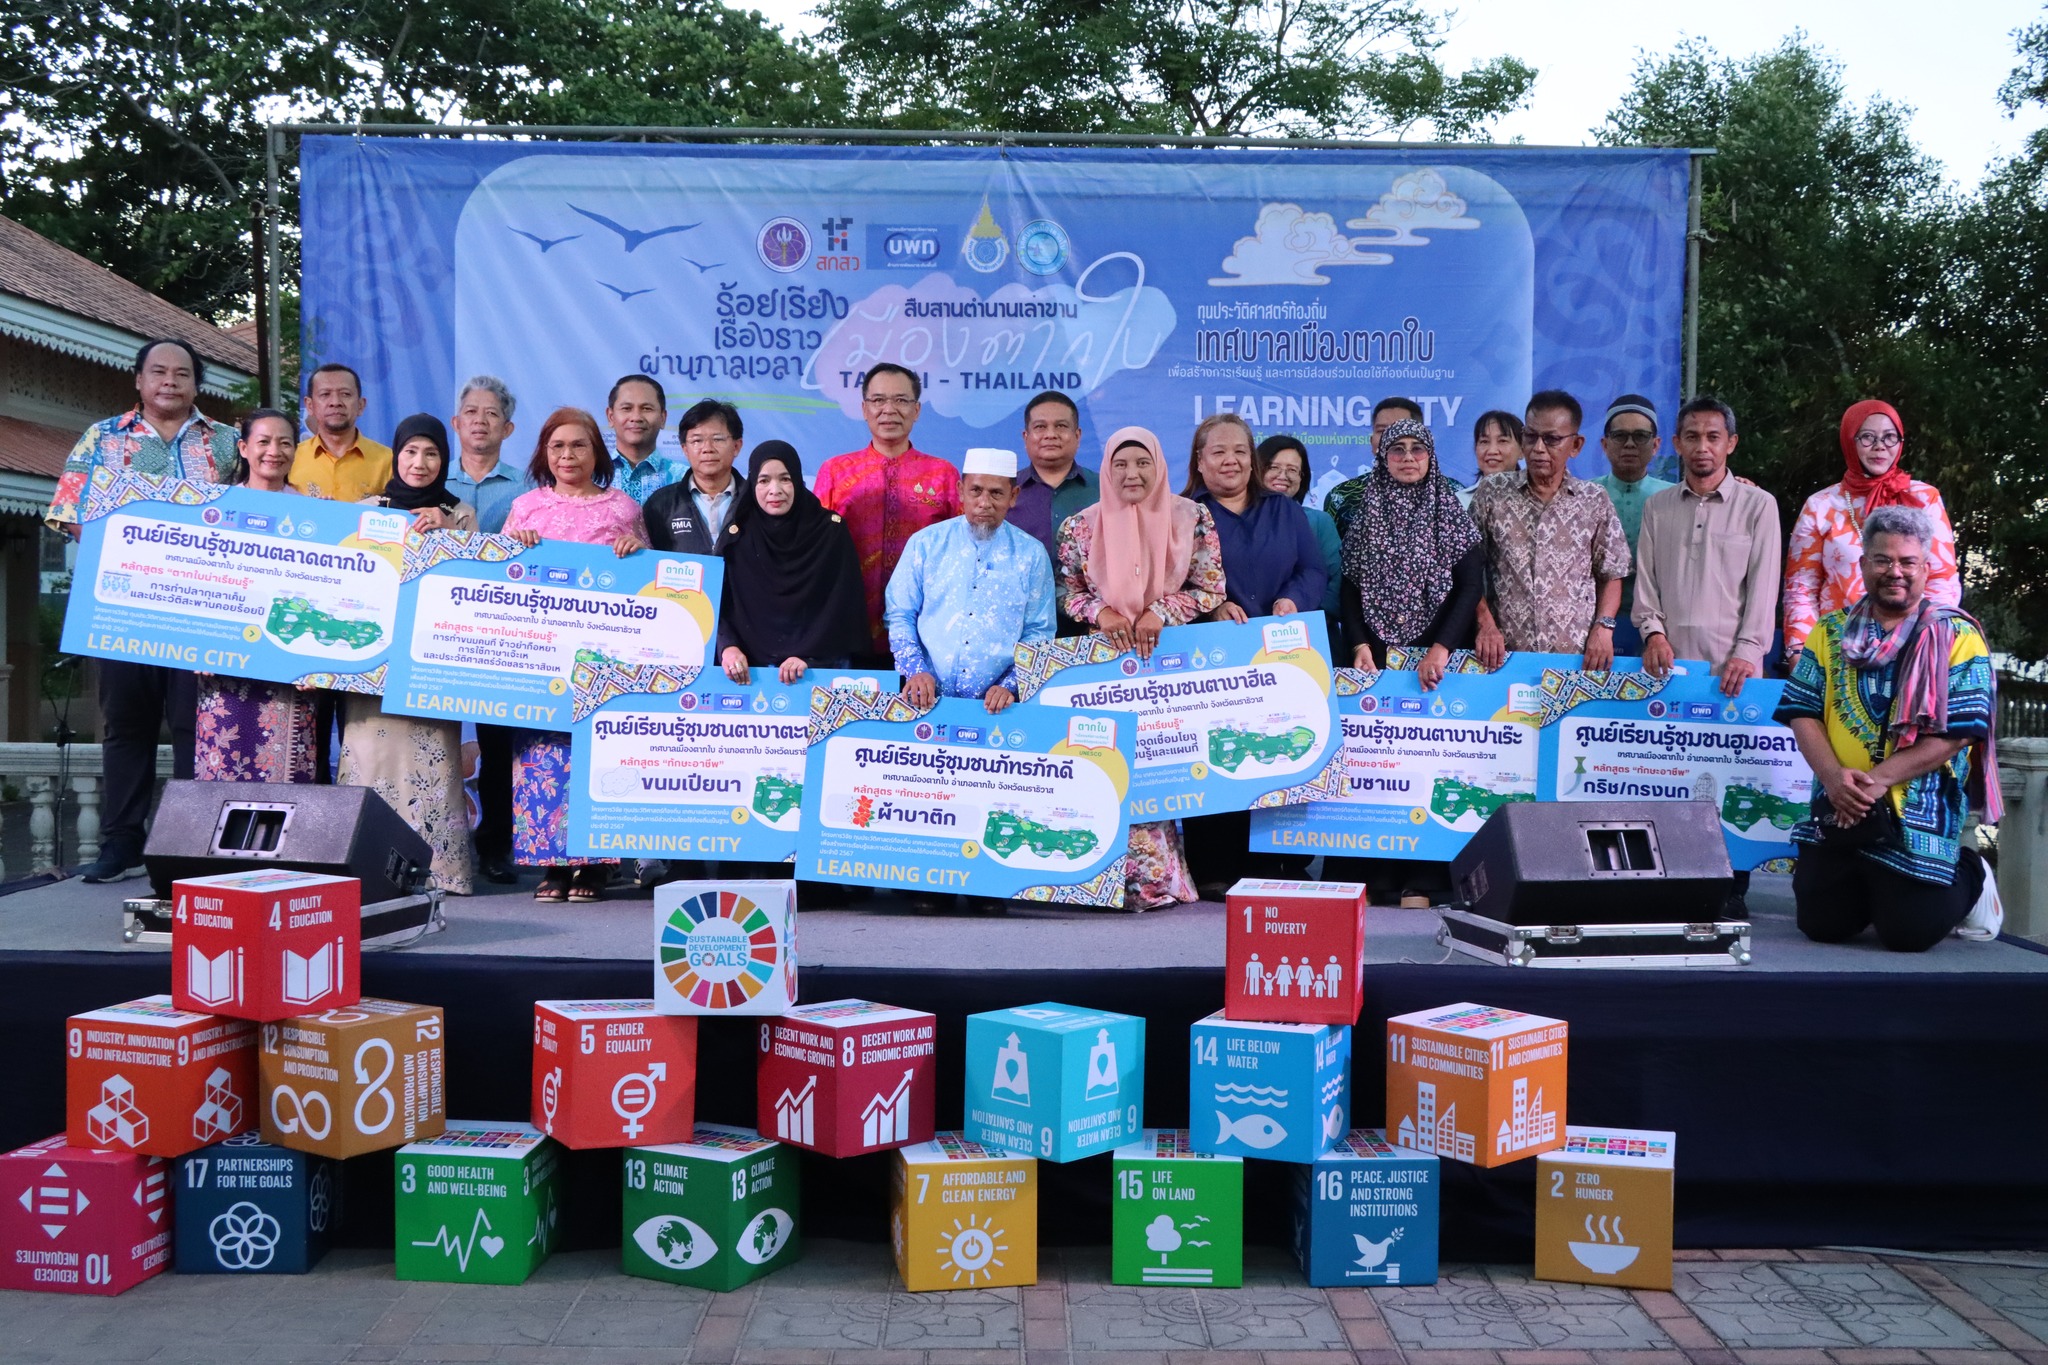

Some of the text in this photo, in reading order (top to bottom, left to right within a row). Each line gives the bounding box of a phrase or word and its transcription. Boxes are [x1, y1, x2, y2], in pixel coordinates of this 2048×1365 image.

[889, 240, 936, 255] บพท
[816, 256, 860, 271] สกสว
[716, 281, 849, 320] ร้อยเรียง
[904, 296, 1078, 318] สืบสานตำนานเล่าขาน
[1197, 297, 1327, 325] ทุนประวัติศาสตร์ท้องถิ่น
[714, 313, 822, 350] เรื่องราว
[1196, 316, 1435, 363] เทศบาลเมืองตากใบ
[639, 346, 804, 381] ผ่านกาลเวลา
[1168, 362, 1263, 381] เพื่อสร้างการเรียนรู้
[960, 371, 1082, 390] THAILAND
[369, 517, 399, 529] ตากใบ
[122, 523, 377, 574] ศูนย์เรียนรู้ชุมชนตลาดตากใบ
[121, 559, 164, 577] หลักสูตร
[666, 565, 694, 576] ตากใบ
[450, 583, 658, 620] ศูนย์เรียนรู้ชุมชนบางน้อย
[1271, 626, 1299, 637] ตากใบ
[87, 633, 251, 670] LEARNING CITY
[1070, 668, 1277, 708] ศนย์เรียนรู้ชุมชนตาบาฮีเล
[405, 692, 557, 722] LEARNING CITY
[1078, 722, 1107, 733] ตากใบ
[1341, 718, 1523, 745] รียนรู้ชุมชนตาบาปาเร๊ะ
[1576, 721, 1800, 755] ศูนย์เรียนรู้ชุมชนฮูมอลา
[620, 757, 660, 769] หลักสูตร
[855, 745, 1074, 779] ศูนย์เรียนรู้ชุมชนภัทรภักดี
[1593, 763, 1630, 775] หลักสูตร
[641, 773, 742, 793] ขนมเปียนา
[853, 784, 892, 797] หลักสูตร
[1584, 778, 1690, 799] กริช/กรงนก
[878, 801, 957, 827] ผ้าบาติก
[1164, 792, 1206, 812] CITY
[588, 833, 742, 853] LEARNING CITY
[1272, 830, 1420, 852] LEARNING CITY
[816, 858, 971, 887] LEARNING CITY
[176, 894, 224, 924] 4 QUALITY
[194, 912, 234, 930] EDUCATION
[269, 895, 322, 931] 4 QUALITY
[289, 910, 333, 929] EDUCATION
[1243, 906, 1278, 934] 1 NO
[689, 935, 747, 943] SUSTAINABLE
[1265, 922, 1307, 935] POVERTY
[690, 952, 747, 967] GOALS
[263, 1024, 279, 1055] 12
[283, 1027, 326, 1046] RESPONSIBLE
[415, 1015, 441, 1043] 12
[580, 1024, 596, 1055] 5
[606, 1023, 644, 1037] GENDER
[760, 1023, 834, 1053] 8 DECENT WORK AND
[69, 1027, 175, 1059] 9 INDUSTRY, INNOVATION
[283, 1043, 329, 1064] CONSUMPTION
[606, 1038, 652, 1054] EQUALITY
[775, 1042, 835, 1068] ECONOMIC GROWTH
[842, 1026, 933, 1067] 8 DECENT WORK AND
[861, 1042, 934, 1065] ECONOMIC GROWTH
[1194, 1036, 1280, 1066] 14 LIFE BELOW
[1390, 1033, 1489, 1065] 11 SUSTAINABLE CITIES
[1490, 1025, 1567, 1071] 11 SUSTAINABLE CITIES
[1508, 1043, 1562, 1067] AND COMMUNITIES
[87, 1047, 172, 1068] AND INFRASTRUCTURE
[1226, 1054, 1258, 1070] WATER
[1411, 1054, 1484, 1080] AND COMMUNITIES
[283, 1060, 339, 1082] AND PRODUCTION
[430, 1048, 442, 1115] RESPONSIBLE
[404, 1054, 415, 1140] AND PRODUCTION
[416, 1050, 429, 1123] CONSUMPTION
[972, 1108, 1033, 1136] AND SANITATION
[1068, 1108, 1121, 1133] AND SANITATION
[981, 1128, 1006, 1146] WATER
[1008, 1135, 1032, 1152] CLEAN
[1077, 1130, 1099, 1148] WATER
[1099, 1124, 1121, 1142] CLEAN
[185, 1158, 293, 1188] 17 PARTNERSHIPS
[217, 1175, 292, 1189] FOR THE GOALS
[401, 1163, 494, 1193] 3 GOOD HEALTH
[625, 1158, 689, 1190] 13 CLIMATE
[731, 1157, 775, 1202] 13 CLIMATE
[751, 1175, 773, 1195] ACTION
[1118, 1170, 1173, 1200] 15 LIFE
[1551, 1171, 1600, 1198] 2 ZERO
[427, 1182, 507, 1198] AND WELL-BEING
[653, 1179, 684, 1197] ACTION
[916, 1170, 1026, 1204] 7 AFFORDABLE AND
[942, 1187, 1017, 1203] CLEAN ENERGY
[1152, 1187, 1195, 1201] ON LAND
[1317, 1170, 1429, 1201] 16 PEACE, JUSTICE
[1350, 1187, 1413, 1201] AND STRONG
[1575, 1188, 1614, 1201] HUNGER
[1350, 1203, 1418, 1217] INSTITUTIONS
[16, 1250, 78, 1266] INEQUALITIES
[35, 1253, 112, 1285] 10 REDUCED
